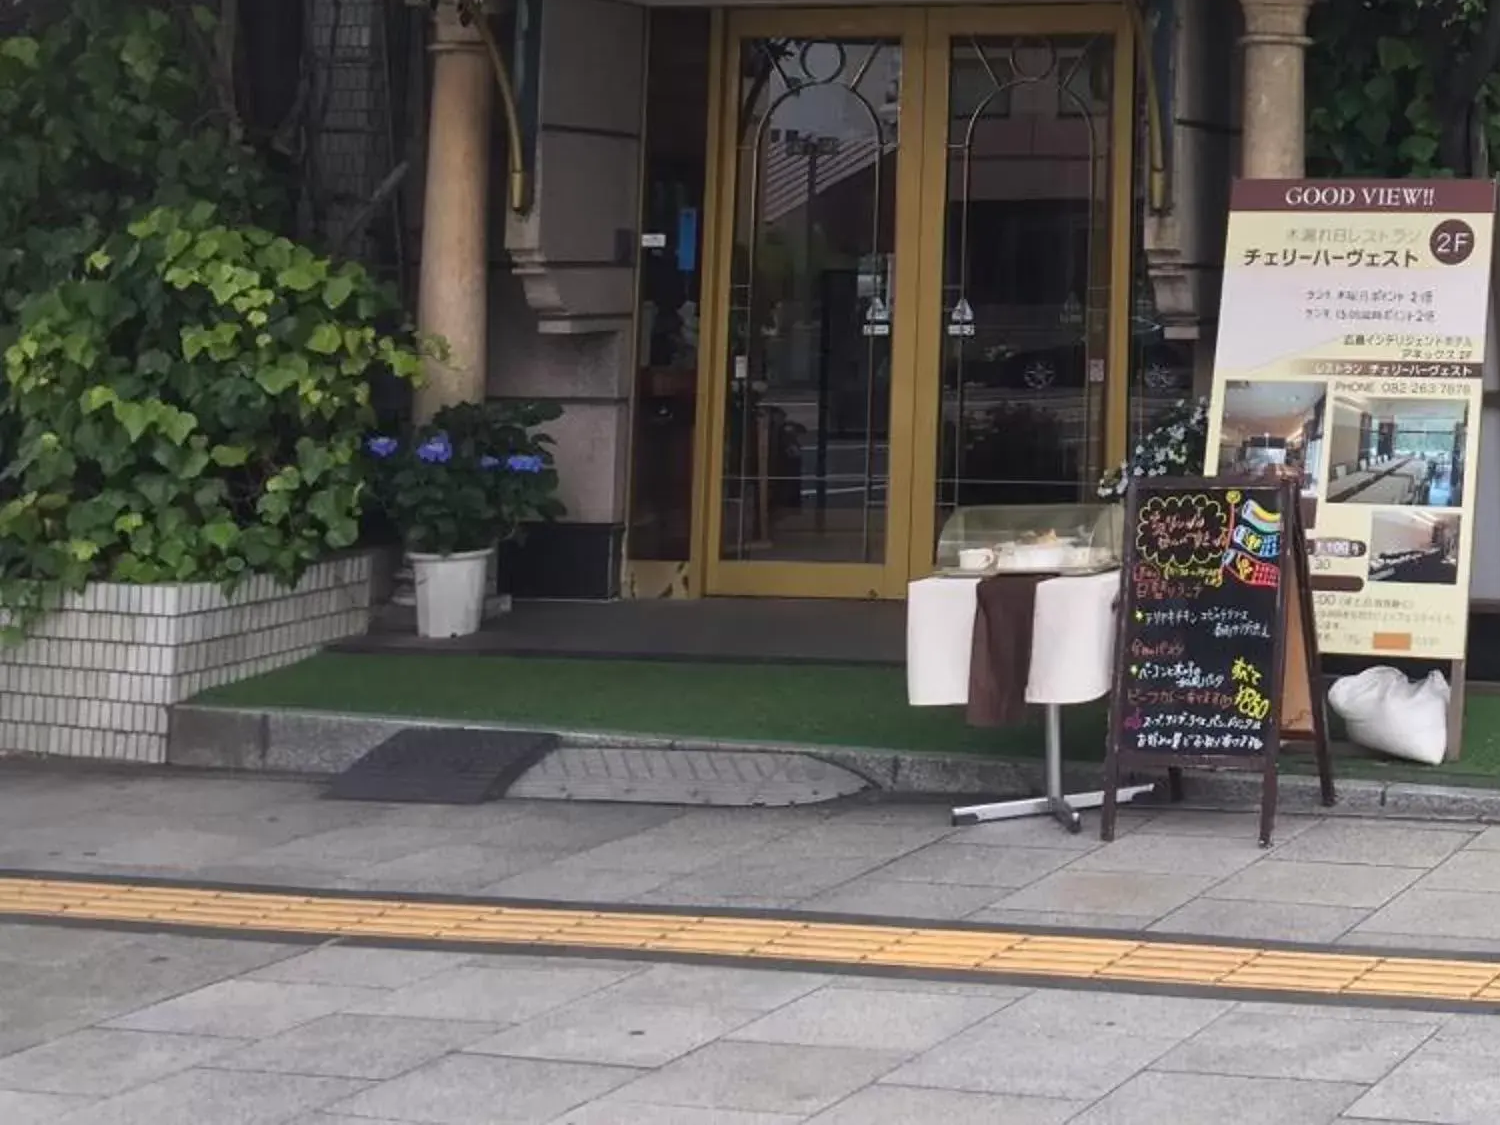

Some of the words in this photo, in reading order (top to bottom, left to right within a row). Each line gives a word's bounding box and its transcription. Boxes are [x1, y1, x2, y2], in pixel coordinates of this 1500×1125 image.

[1285, 187, 1355, 206] GOOD
[1362, 187, 1435, 207] VIEW!!
[1437, 233, 1469, 254] 2F
[1244, 248, 1419, 268] チェリーハーヴェスト
[1369, 364, 1473, 377] チェリーハーヴェスト
[1333, 382, 1375, 393] PHONE
